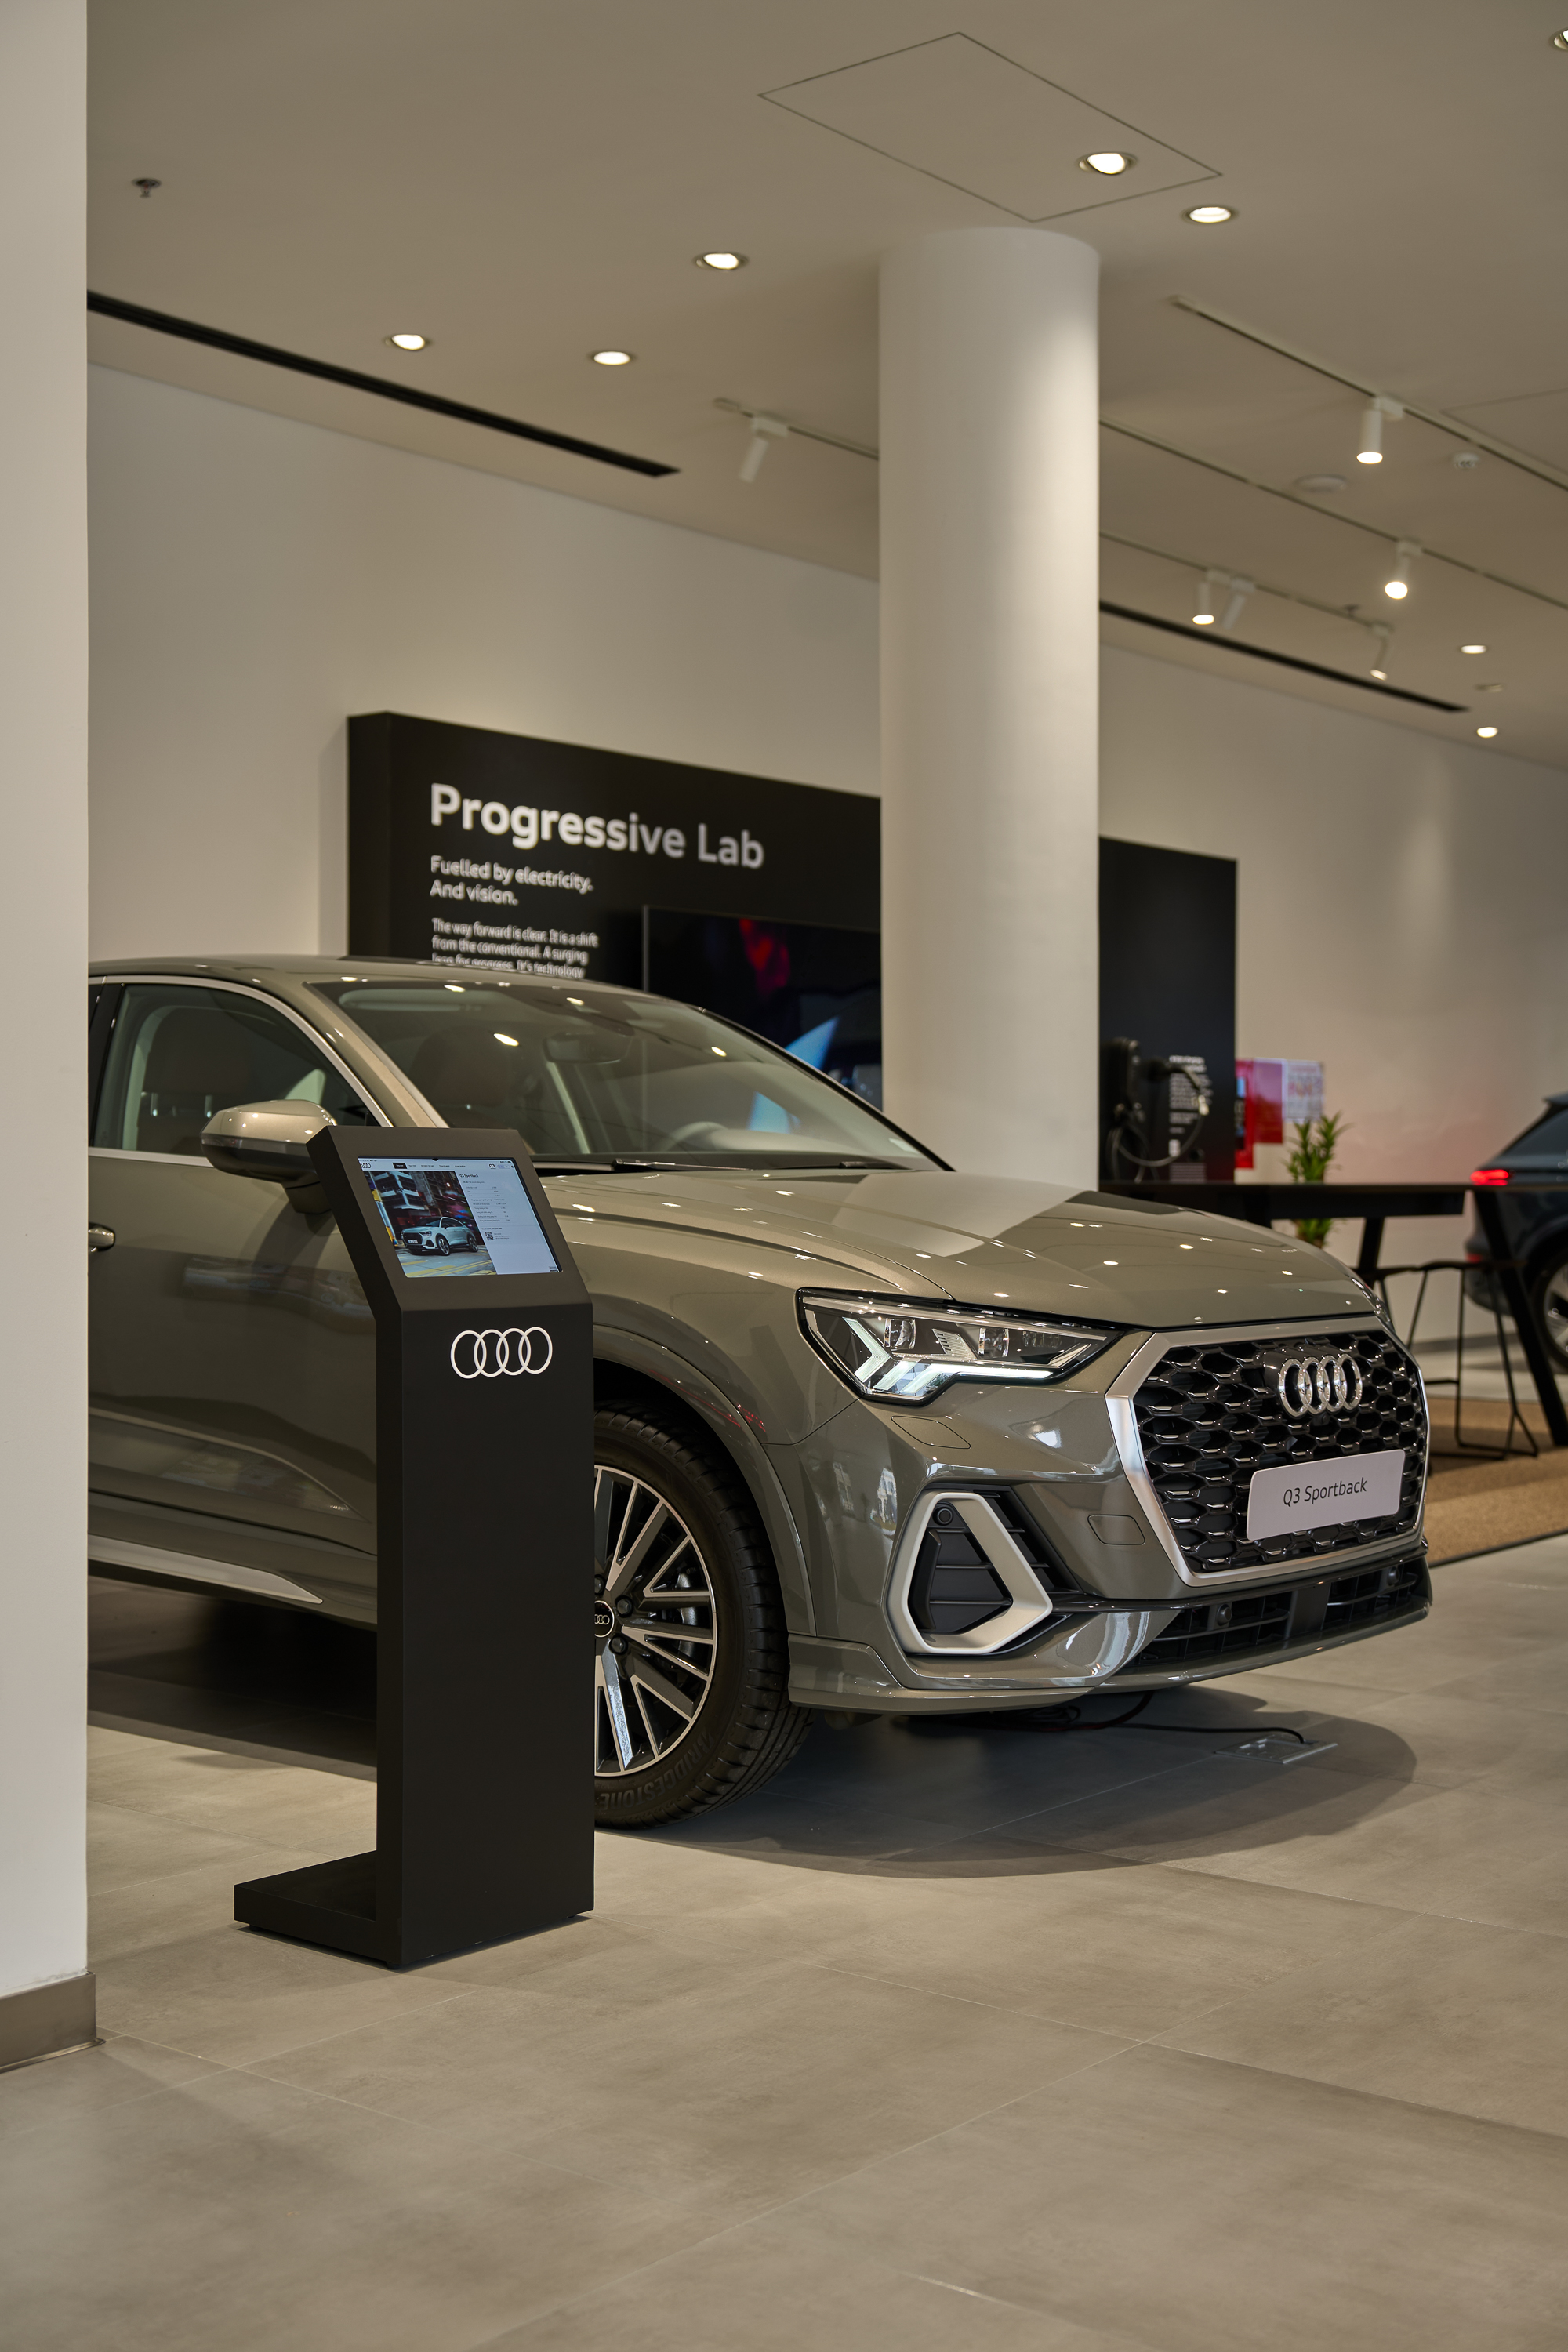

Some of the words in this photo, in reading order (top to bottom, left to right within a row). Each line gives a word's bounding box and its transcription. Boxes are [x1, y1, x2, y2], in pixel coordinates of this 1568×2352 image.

[430, 782, 687, 858] Progressive
[698, 822, 764, 869] Lab
[430, 855, 492, 880] Fuelled
[493, 862, 514, 886] by
[515, 866, 594, 895] electricity.
[430, 879, 465, 900] And
[466, 884, 519, 906] vision.
[431, 918, 452, 935] The
[452, 923, 473, 939] way
[473, 920, 512, 940] forward
[512, 925, 522, 941] is
[521, 926, 549, 942] clear.
[549, 928, 559, 944] It
[559, 930, 568, 946] is
[568, 933, 576, 946] a
[575, 931, 599, 948] shift
[431, 935, 459, 952] from
[459, 937, 477, 954] the
[477, 942, 543, 959] conventional.
[543, 945, 551, 959] A
[551, 947, 589, 966] surging
[1283, 1487, 1301, 1507] Q3
[1304, 1477, 1368, 1504] Sportback
[600, 1730, 715, 1811] BRIDGESTONE
